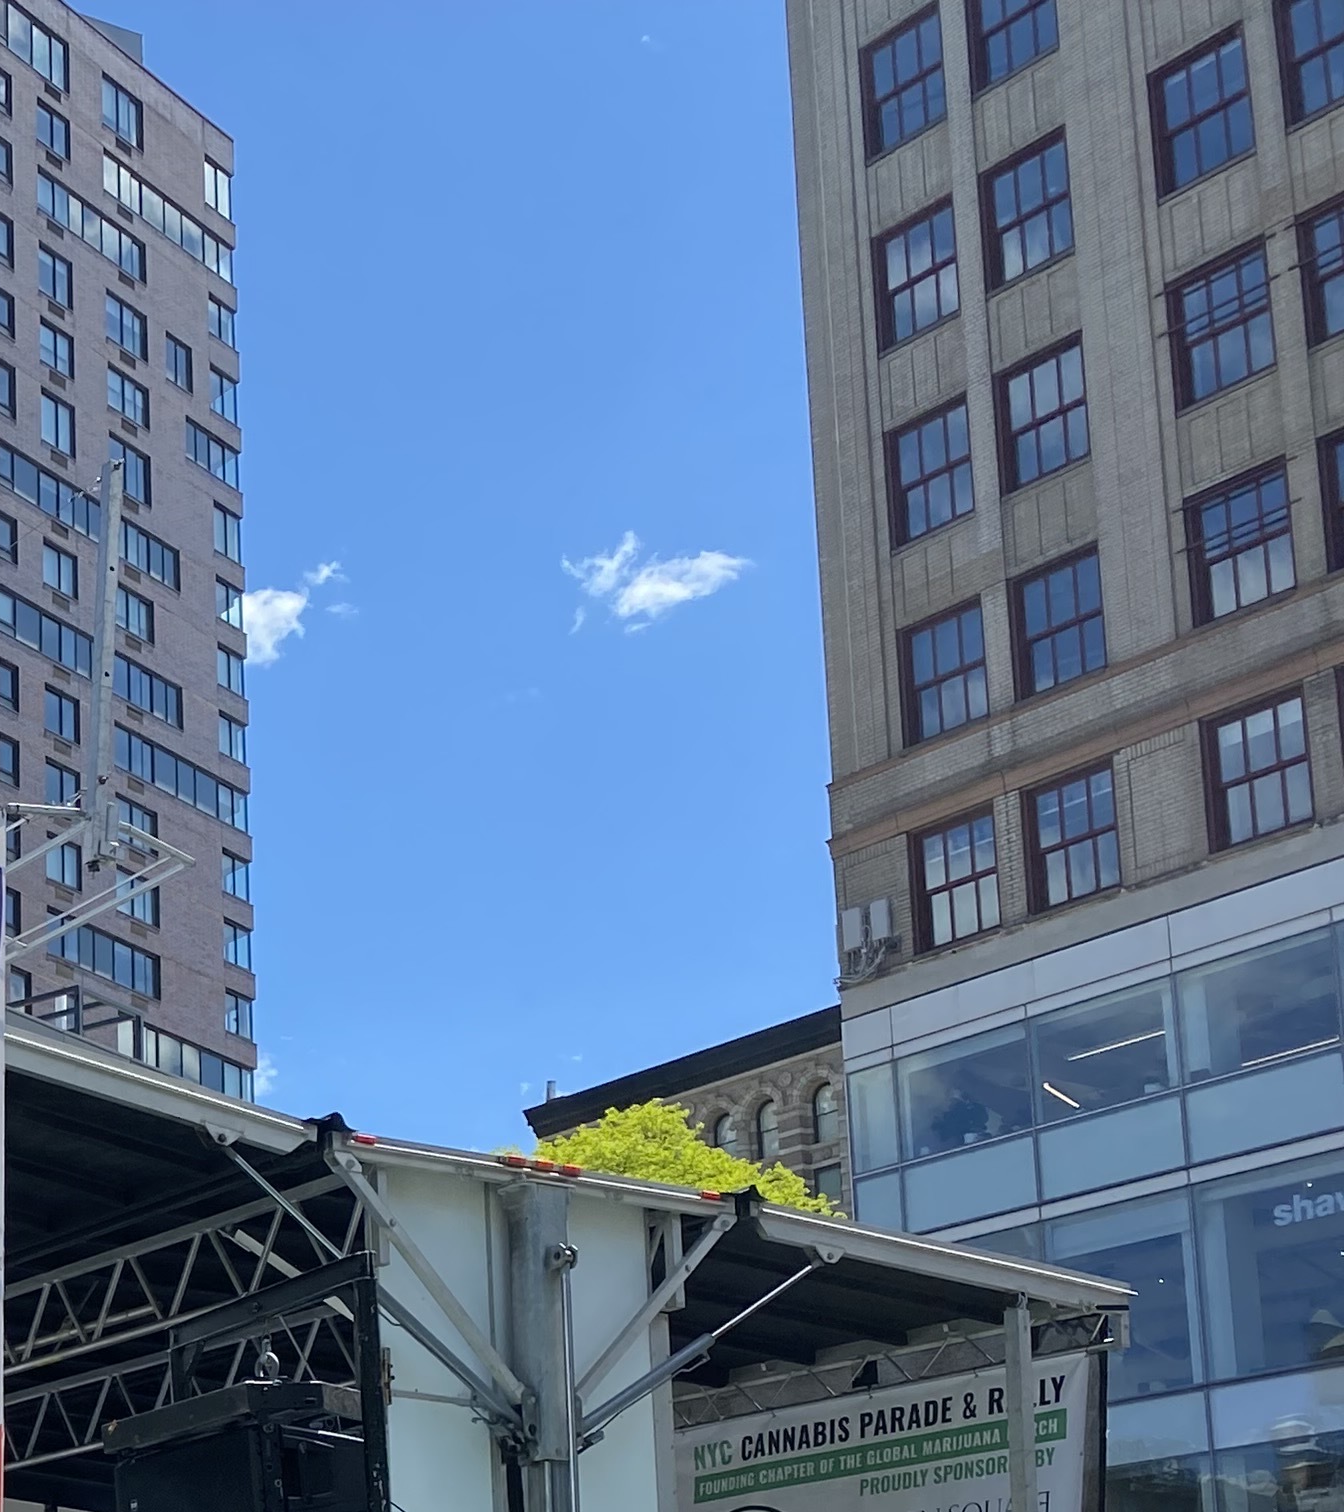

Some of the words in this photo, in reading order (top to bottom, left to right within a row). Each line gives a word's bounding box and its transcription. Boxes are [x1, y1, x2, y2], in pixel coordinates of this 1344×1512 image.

[693, 1440, 734, 1471] NYC
[741, 1416, 850, 1462] CANNABIS
[860, 1395, 953, 1437] PARADE
[962, 1392, 977, 1419] &
[988, 1375, 1066, 1415] RLY
[699, 1473, 755, 1497] FOUNDING
[759, 1461, 814, 1485] CHAPTER
[820, 1459, 836, 1474] OF
[840, 1454, 863, 1470] THE
[867, 1444, 918, 1466] GLOBAL
[922, 1431, 1002, 1457] MARIJUANA
[859, 1467, 929, 1496] PROUDLY
[934, 1453, 1010, 1484] SPONSOR
[1035, 1447, 1056, 1468] BY
